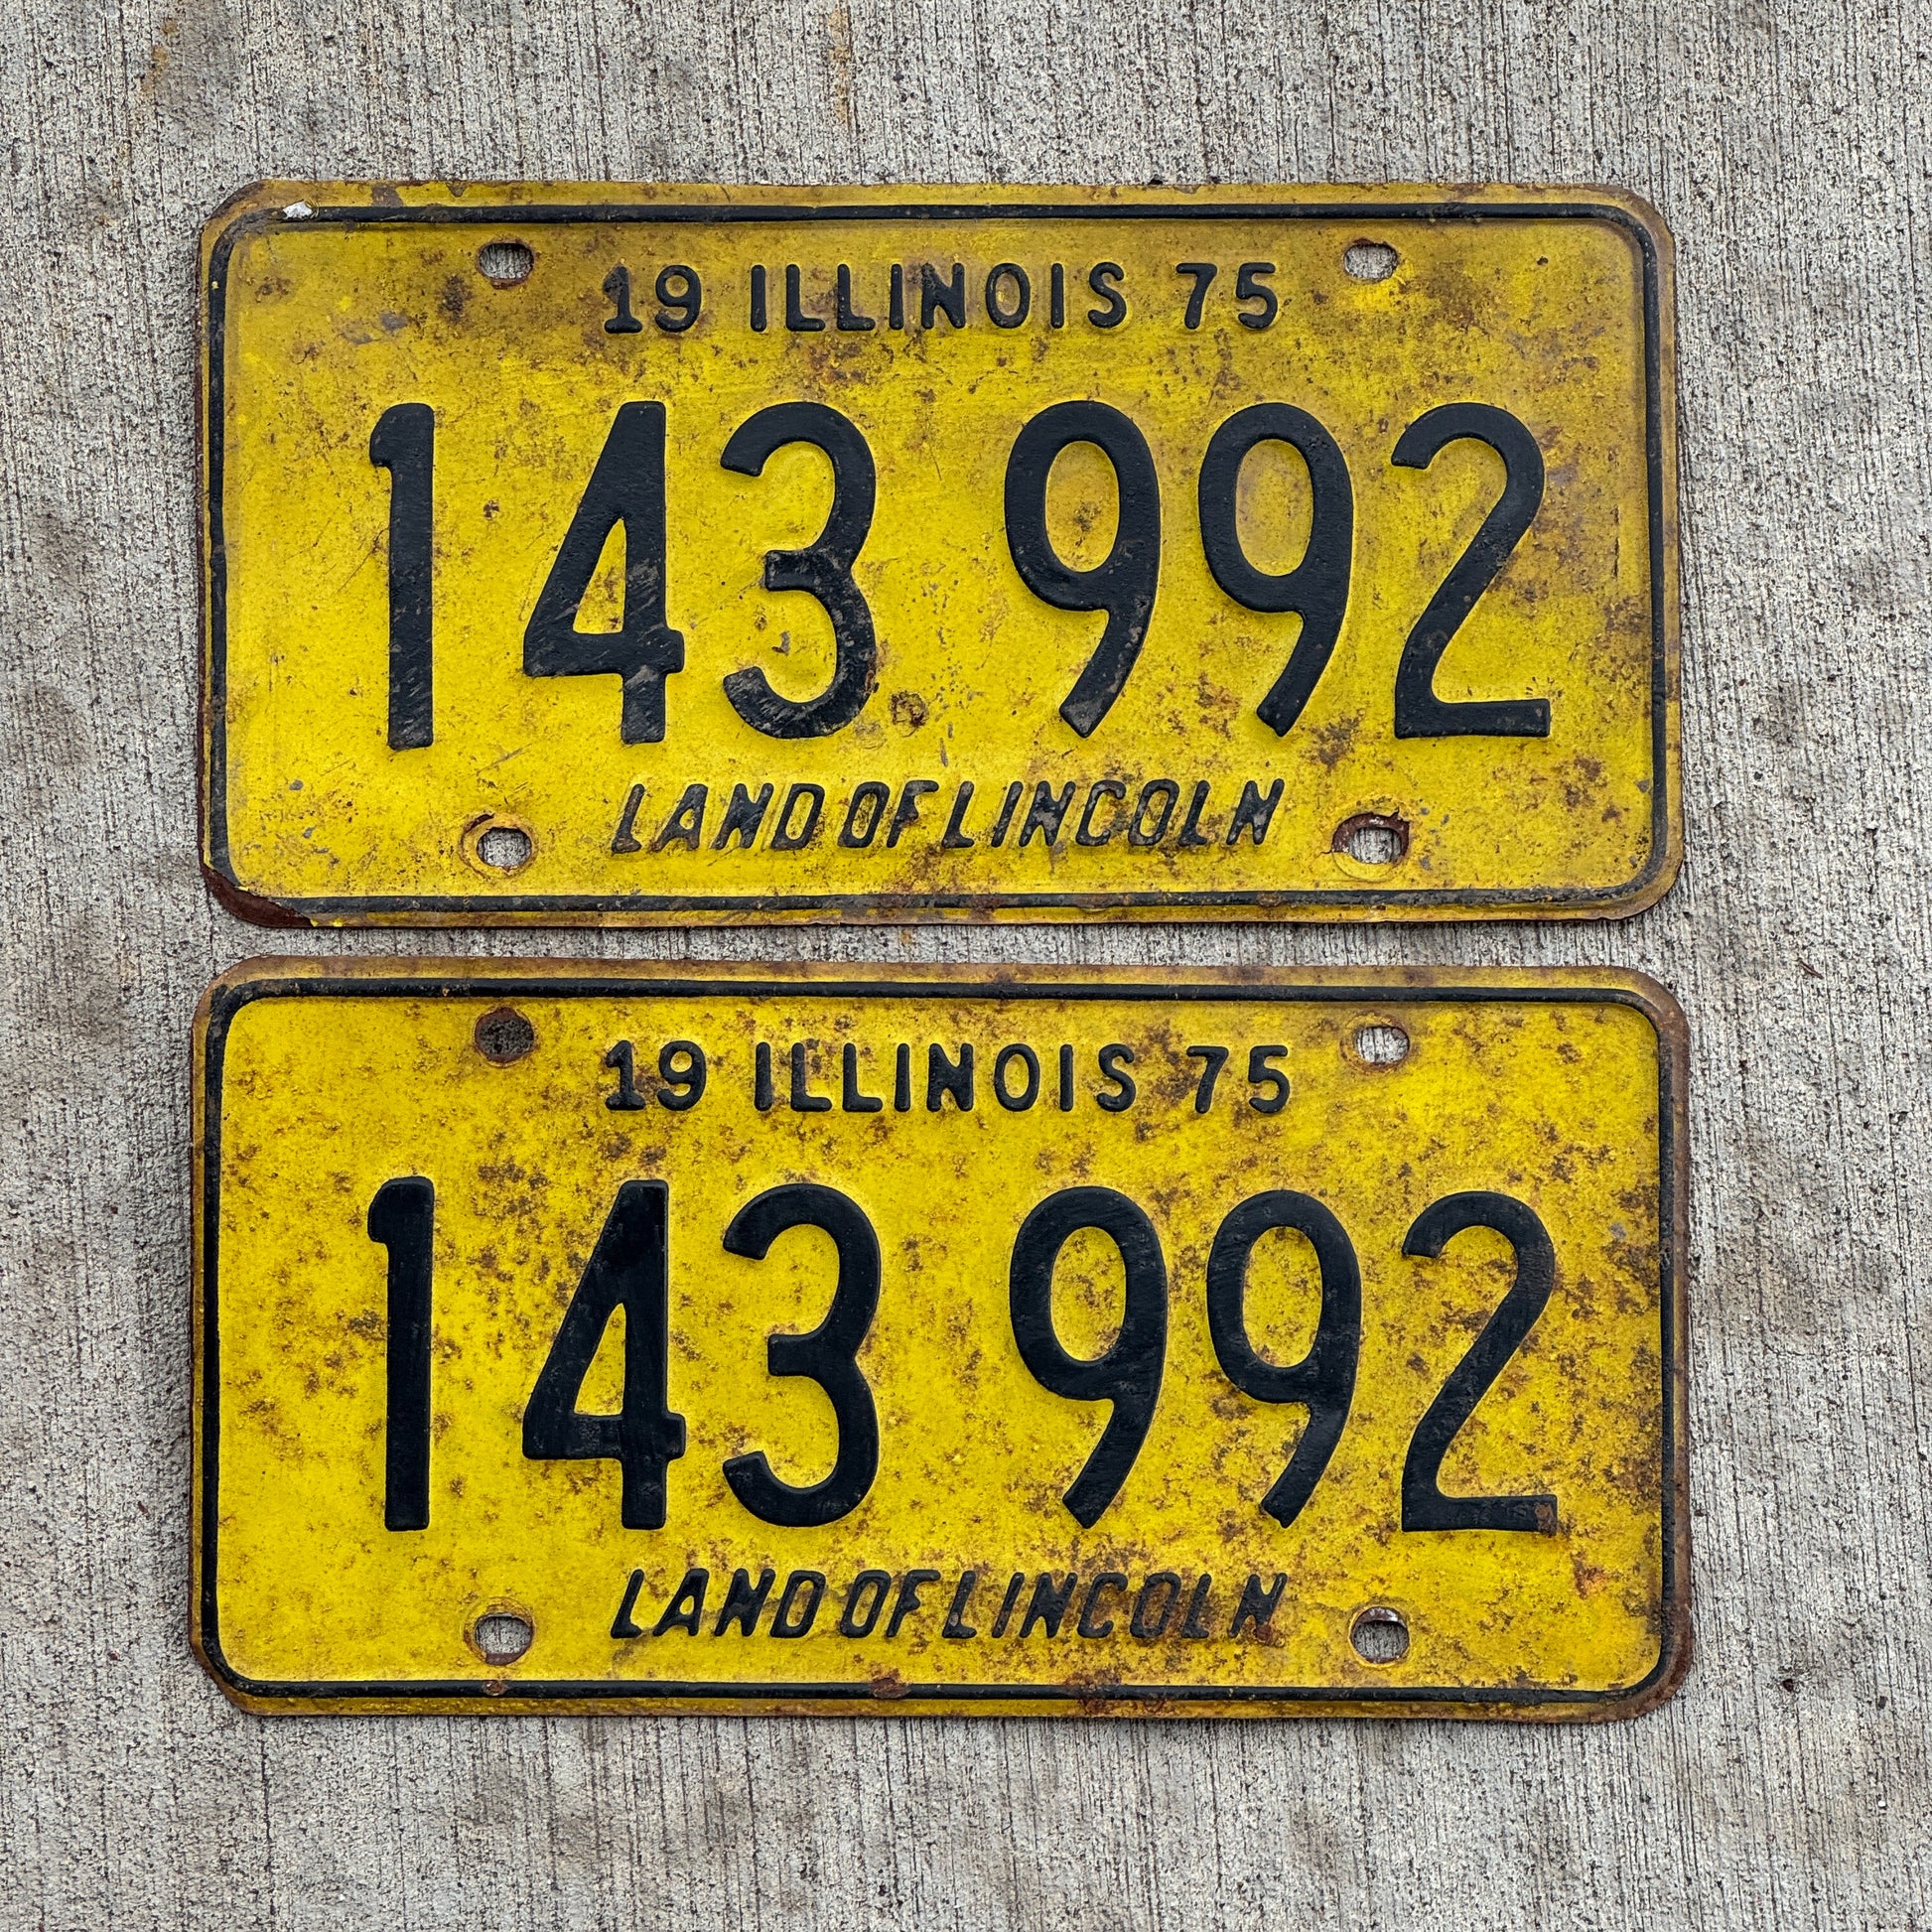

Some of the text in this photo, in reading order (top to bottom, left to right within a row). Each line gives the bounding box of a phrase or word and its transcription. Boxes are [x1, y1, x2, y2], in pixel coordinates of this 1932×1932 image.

[604, 263, 1278, 334] 19 ILLINOIS 75
[370, 401, 1549, 748] 143 992
[612, 779, 1284, 852] LAND OF LINCOLN
[605, 1041, 1289, 1114] 19 ILLINOIS 75
[368, 1177, 1556, 1534] 143 992
[611, 1569, 1287, 1639] LAND OF LINCOLN
